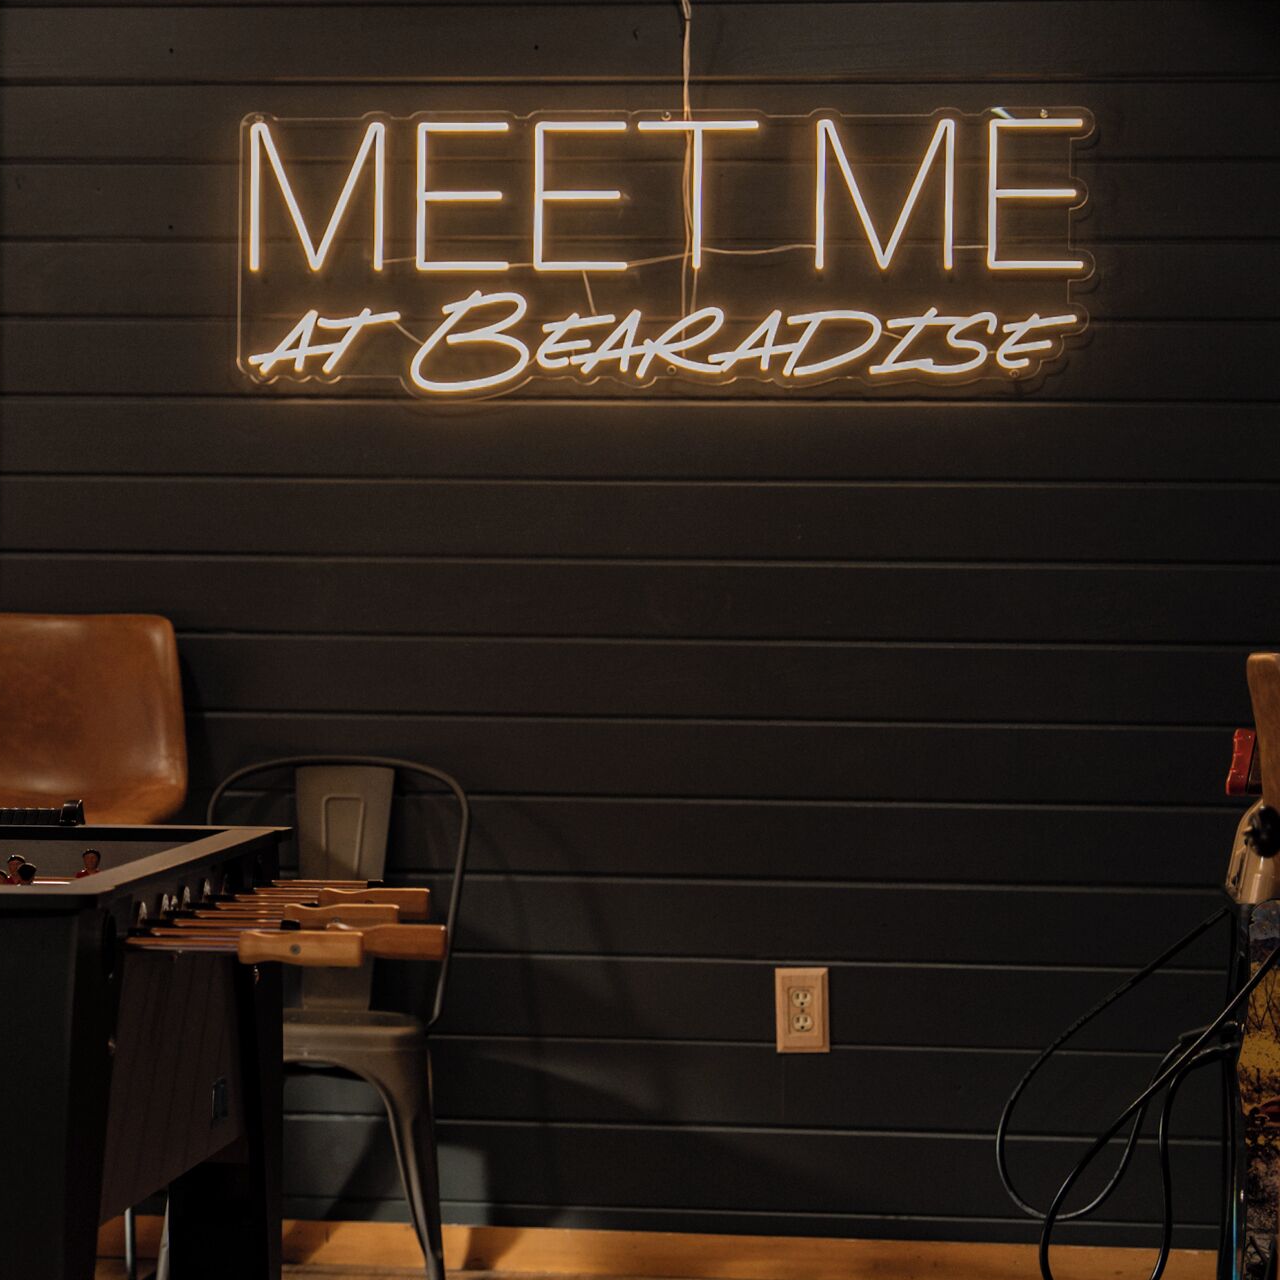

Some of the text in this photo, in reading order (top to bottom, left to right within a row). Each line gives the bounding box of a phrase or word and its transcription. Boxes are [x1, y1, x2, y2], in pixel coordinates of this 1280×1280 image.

[249, 117, 1084, 272] MEET ME
[408, 289, 1078, 394] BEARADISE
